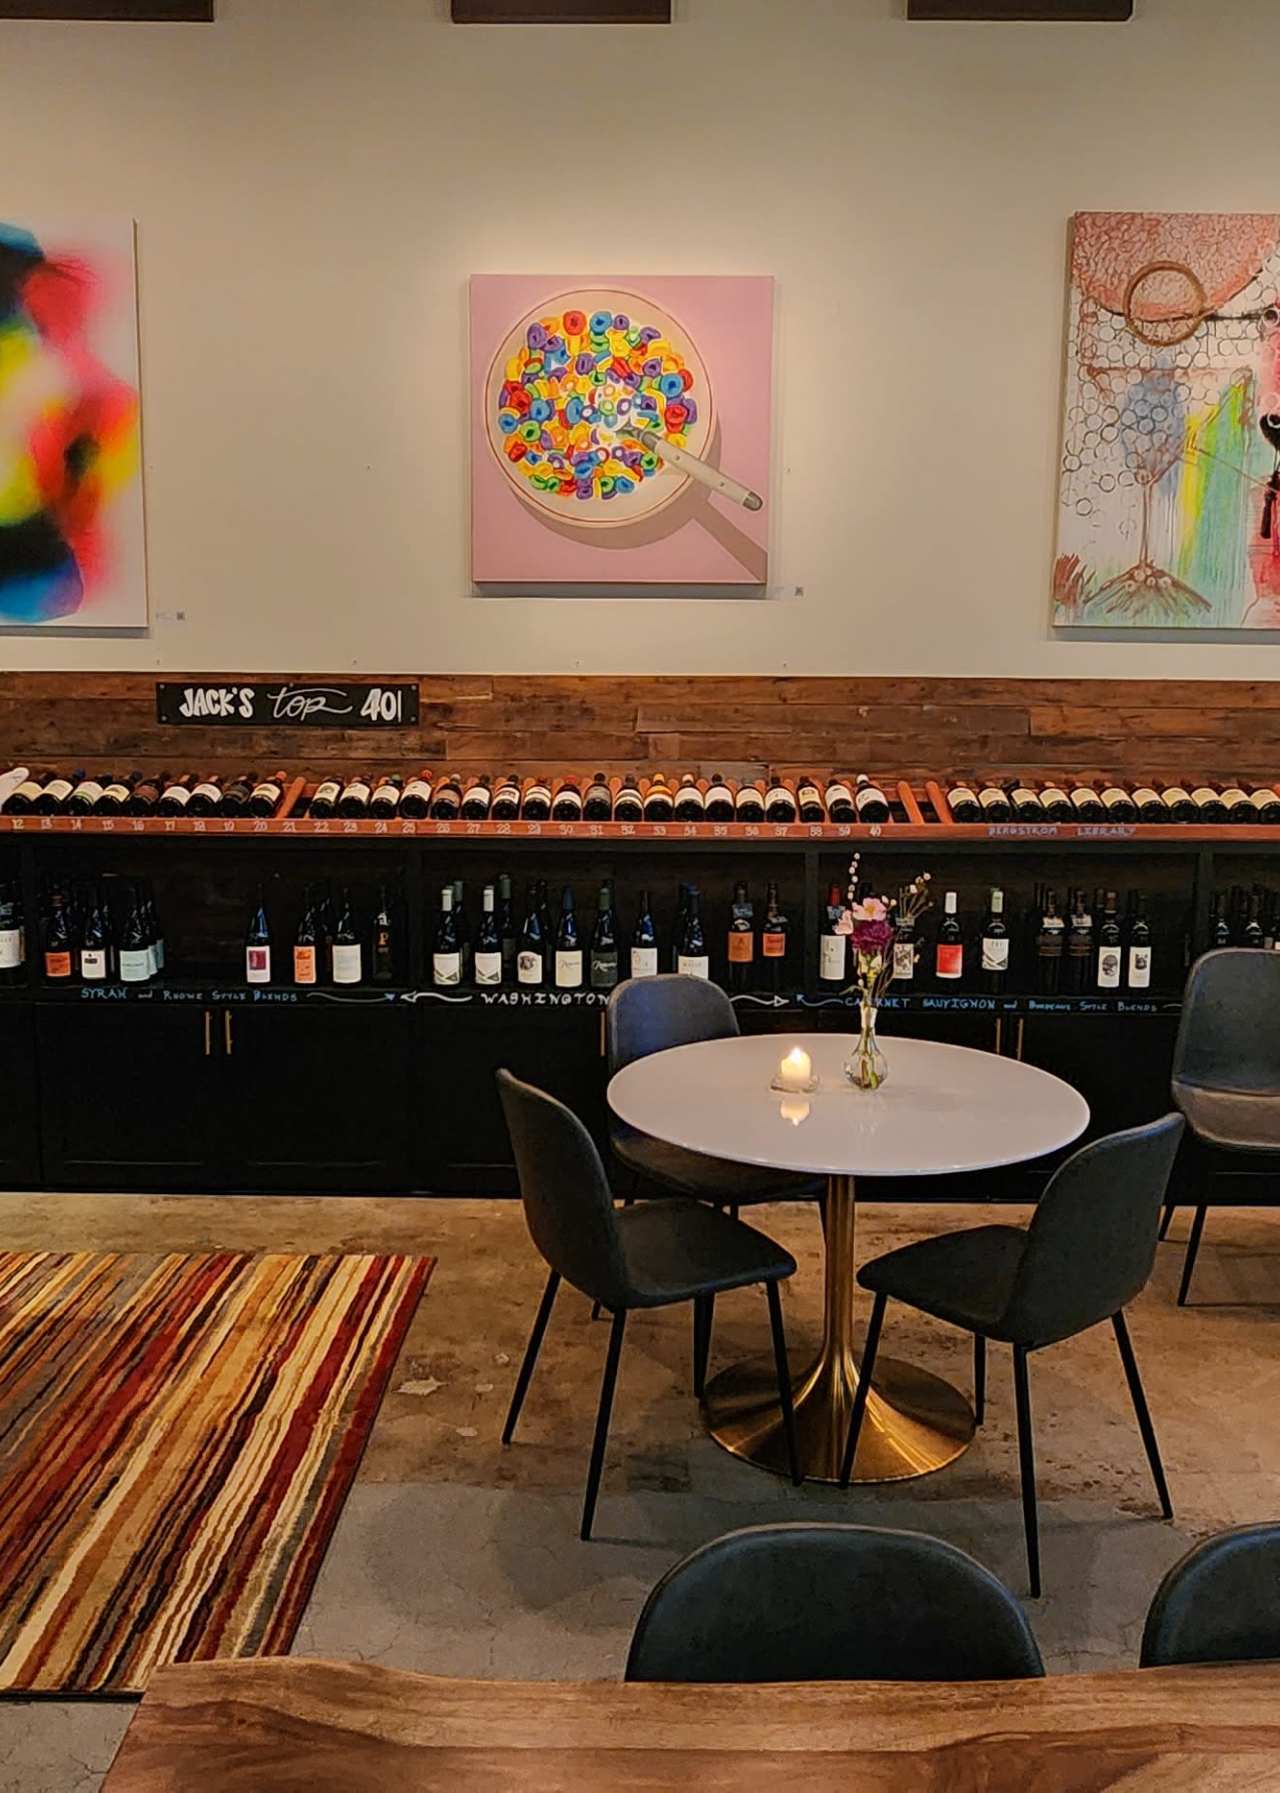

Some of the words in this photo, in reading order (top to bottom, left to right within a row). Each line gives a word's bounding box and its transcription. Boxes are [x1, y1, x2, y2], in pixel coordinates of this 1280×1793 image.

[179, 687, 255, 718] JACK'S
[267, 686, 353, 721] top
[81, 987, 127, 999] SYRAH
[138, 990, 153, 999] and
[481, 992, 611, 1005] WASHINGTON
[845, 998, 910, 1008] CARNET
[923, 998, 996, 1009] SAUVIGNON
